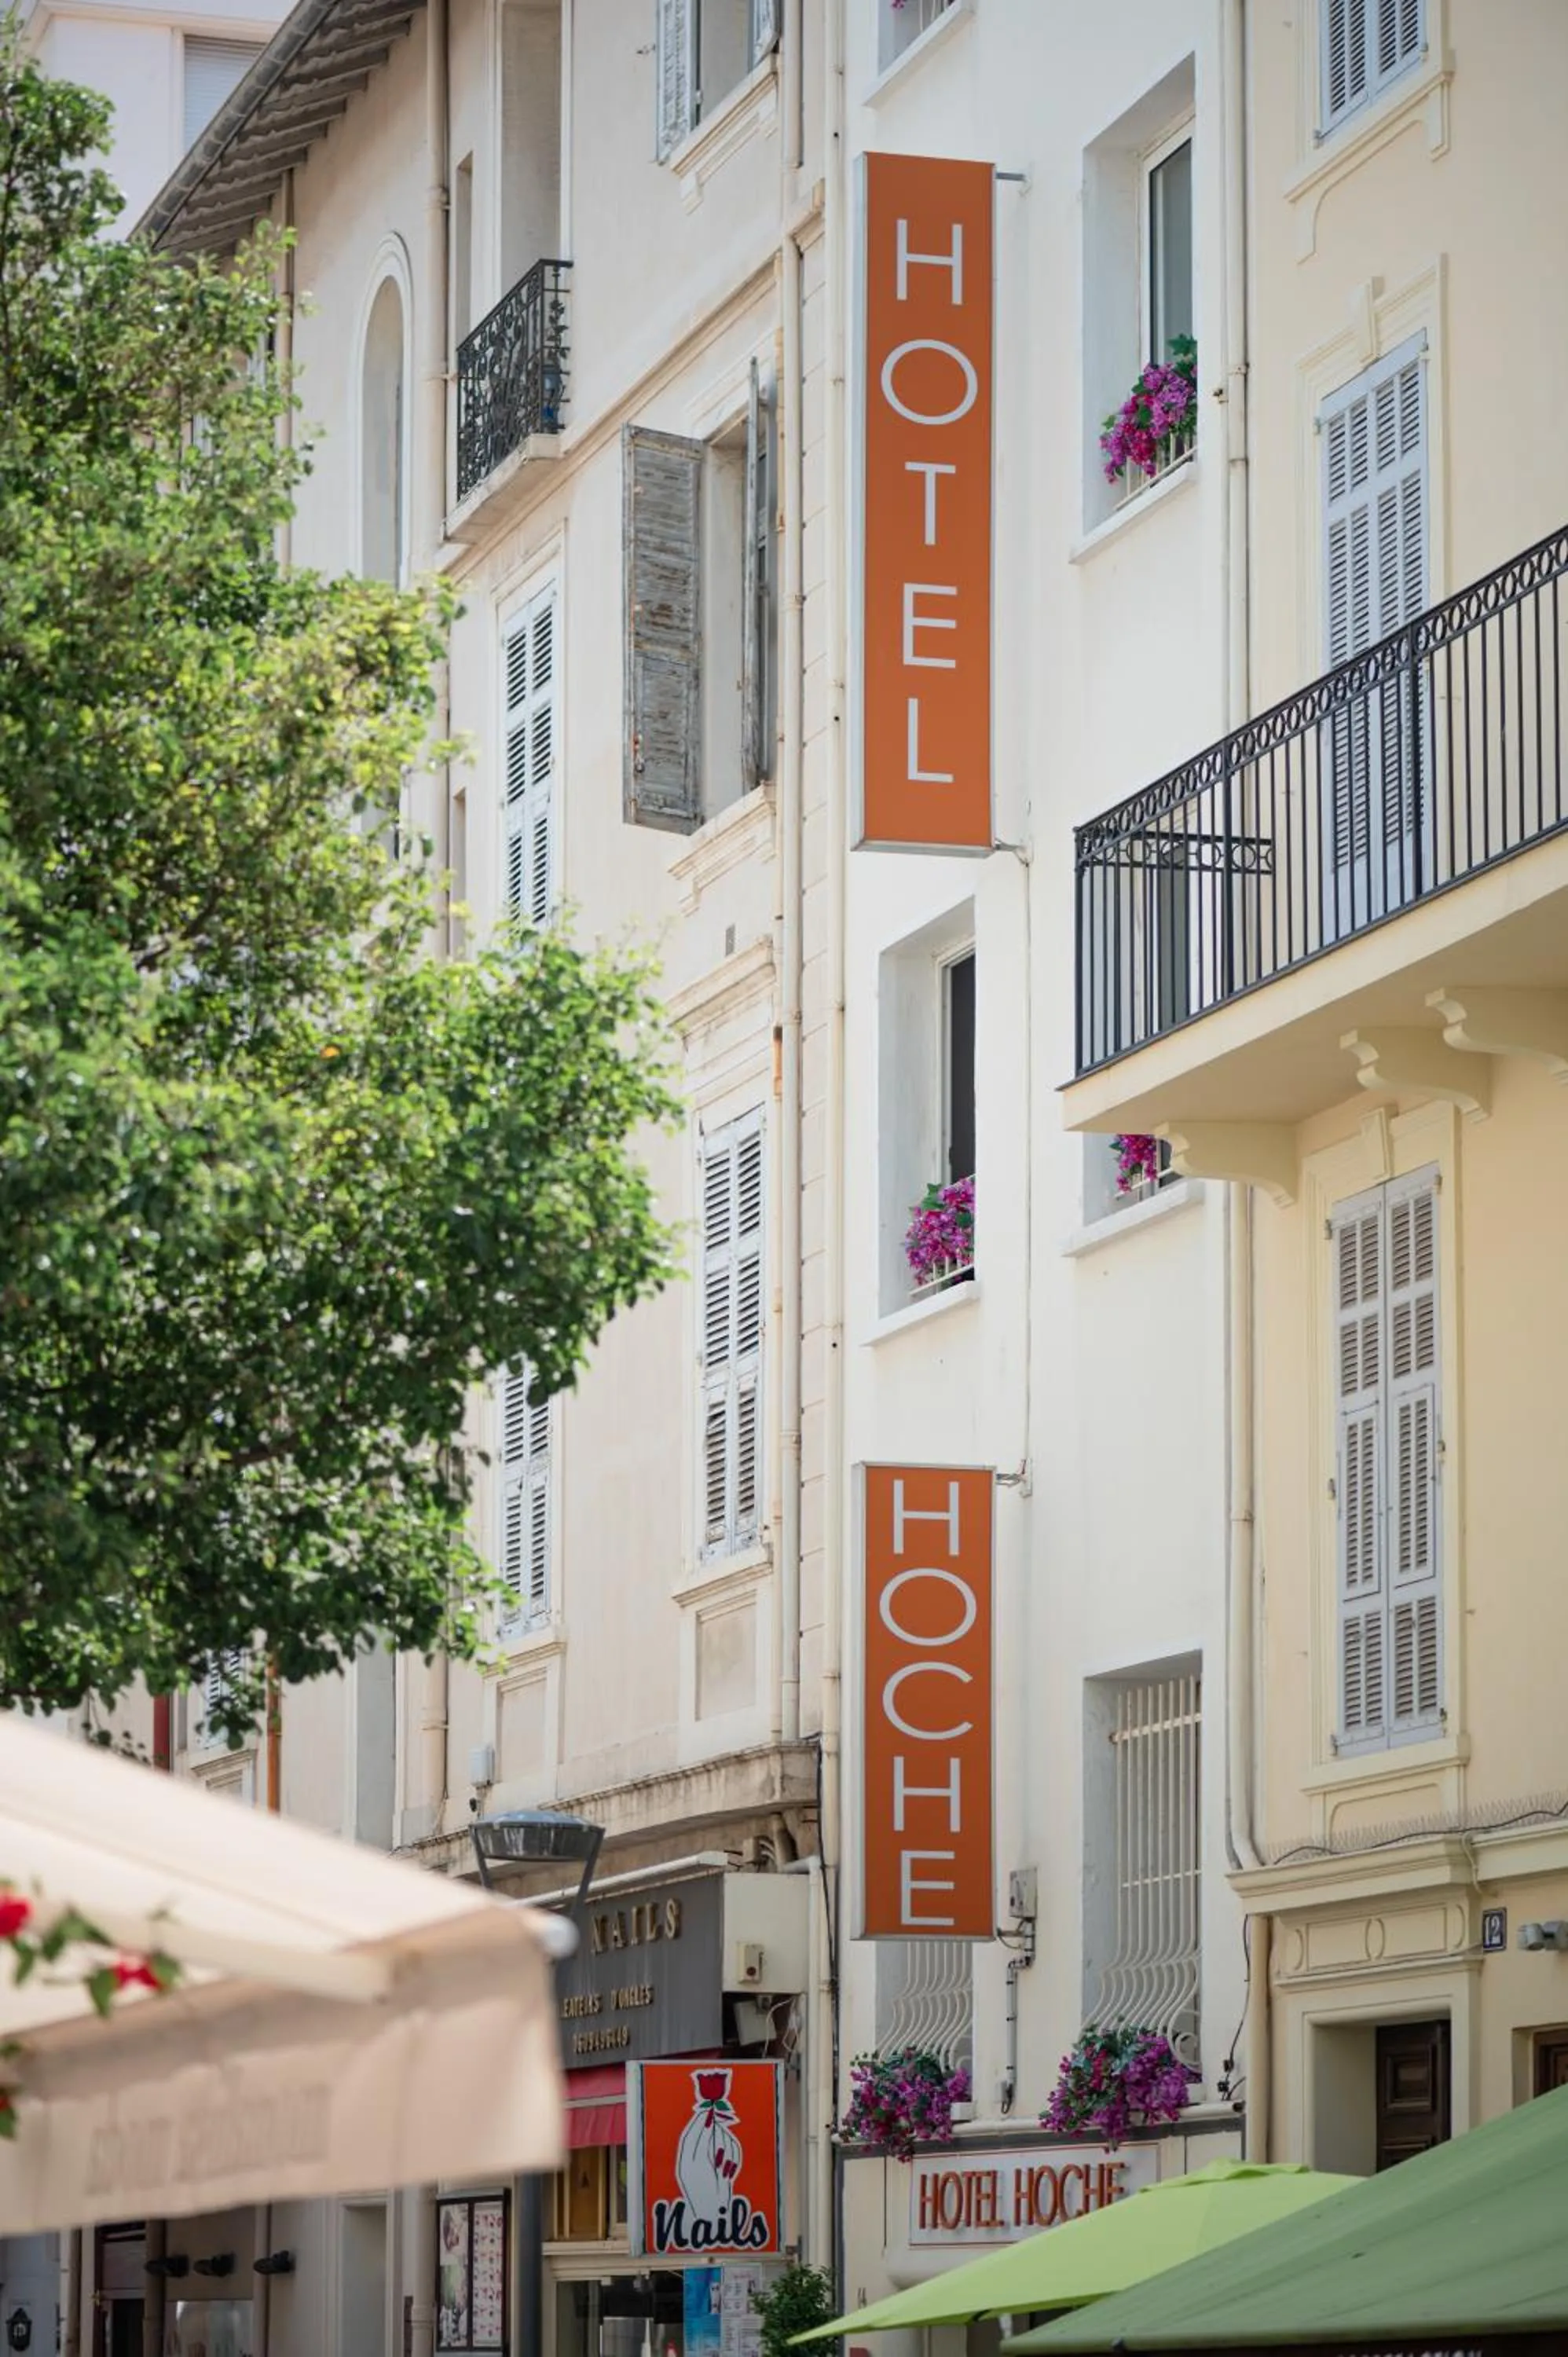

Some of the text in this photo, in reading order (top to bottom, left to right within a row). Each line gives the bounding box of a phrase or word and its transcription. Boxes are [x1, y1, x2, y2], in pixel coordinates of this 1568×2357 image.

[881, 218, 977, 784] HOTEL
[879, 1479, 977, 1926] HOCHE
[592, 1897, 680, 1954] NAILS
[1485, 1915, 1501, 1945] 12
[655, 2198, 768, 2251] Nails
[918, 2162, 1126, 2231] HOTEL HOCHE
